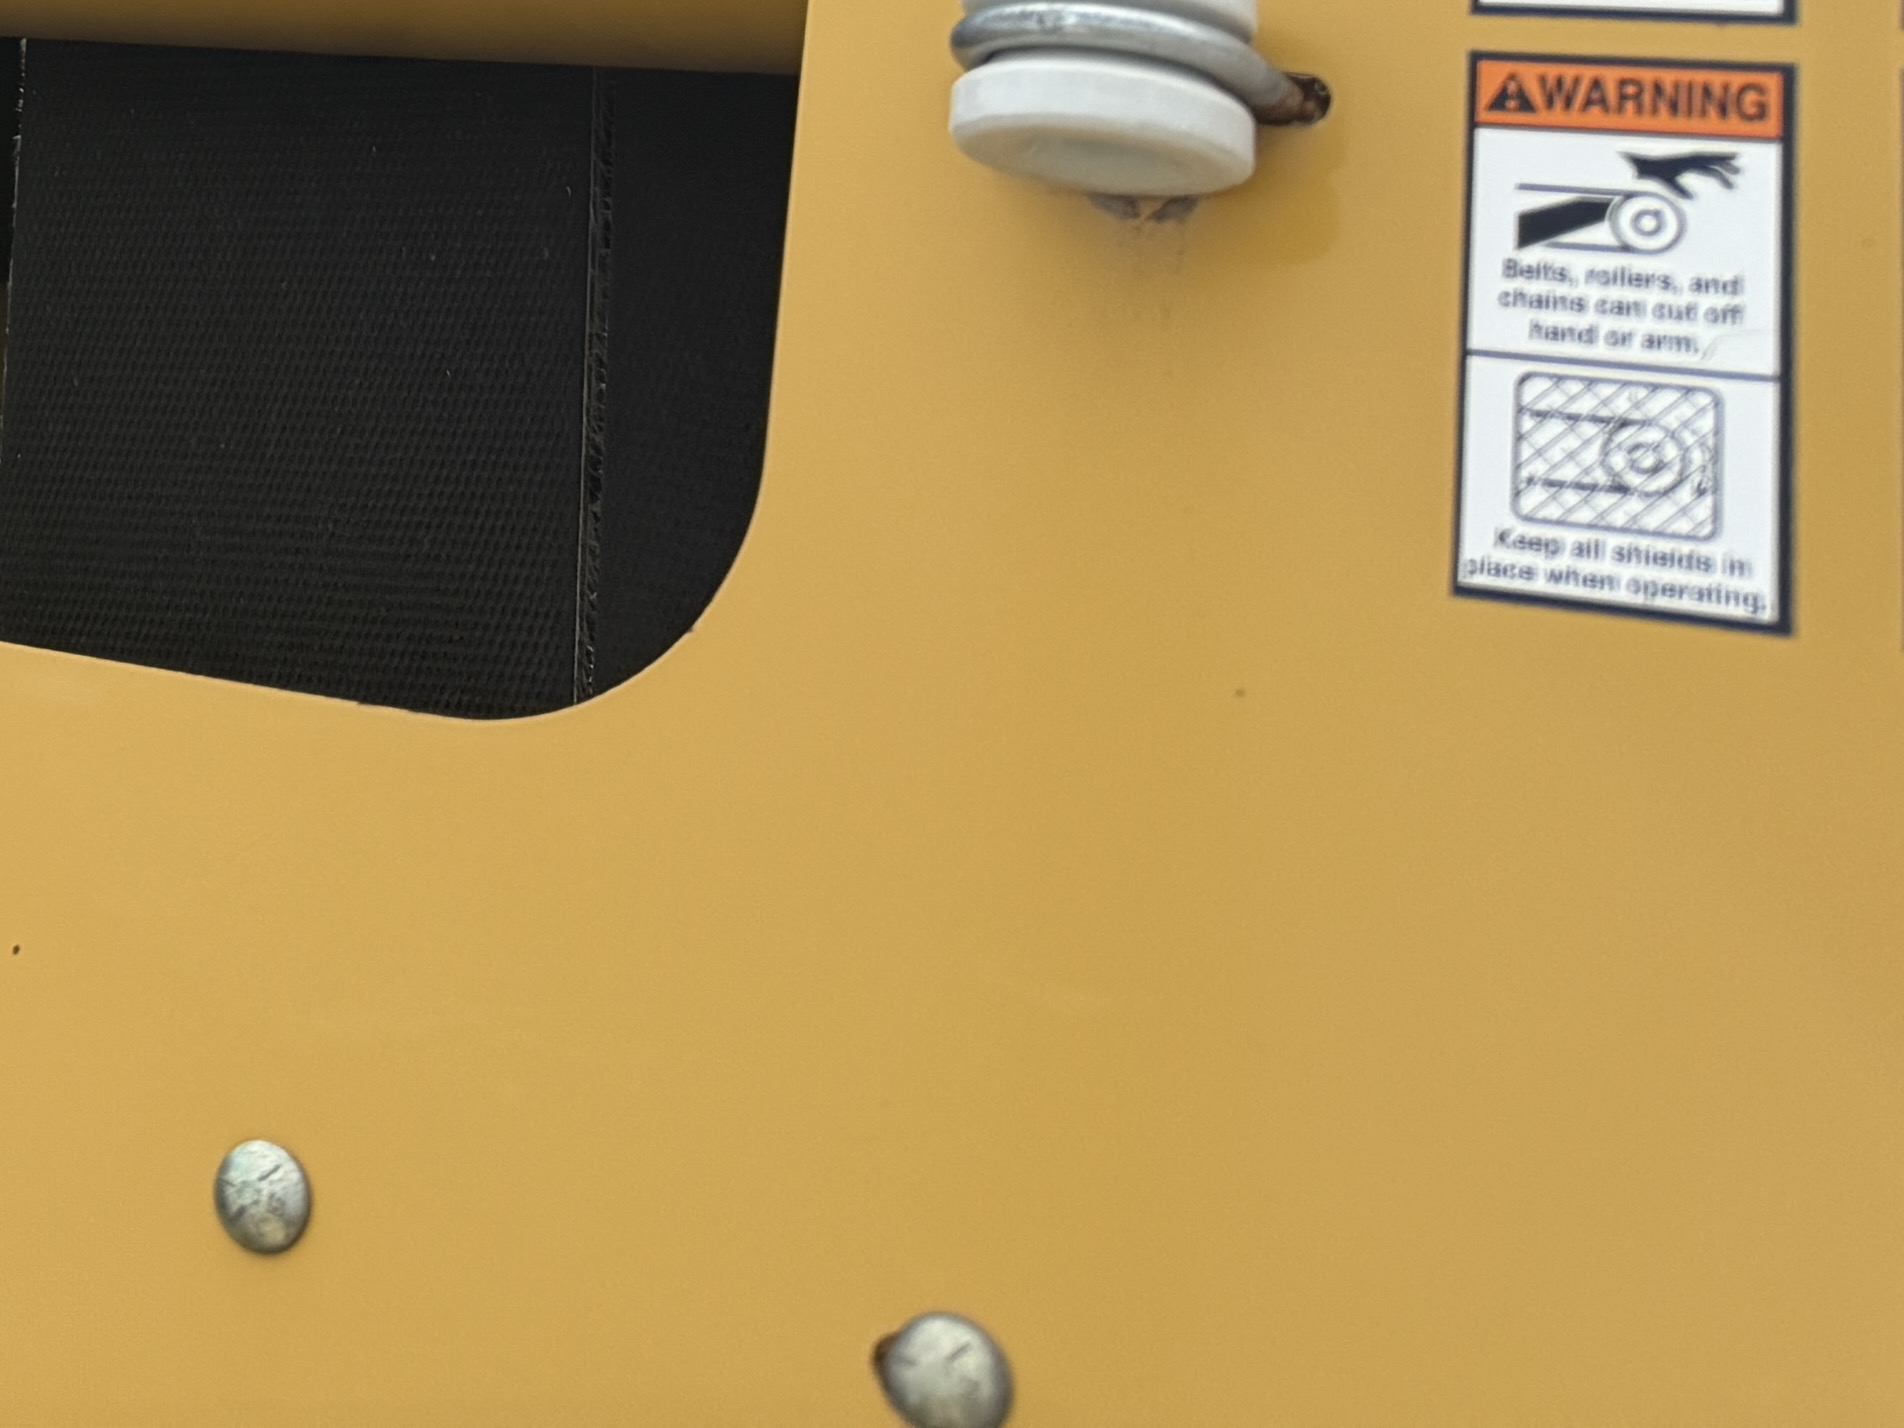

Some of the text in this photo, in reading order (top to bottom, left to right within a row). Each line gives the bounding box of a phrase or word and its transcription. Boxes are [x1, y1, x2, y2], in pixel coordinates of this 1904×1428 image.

[1538, 74, 1769, 122] WARNING
[1502, 258, 1744, 295] Belts, rollers, and
[1497, 288, 1744, 325] chains can cut off
[1528, 320, 1597, 344] hand
[1604, 330, 1633, 346] or
[1494, 527, 1753, 578] Keep all shields in
[1544, 566, 1620, 593] when
[1626, 577, 1767, 617] operating.
